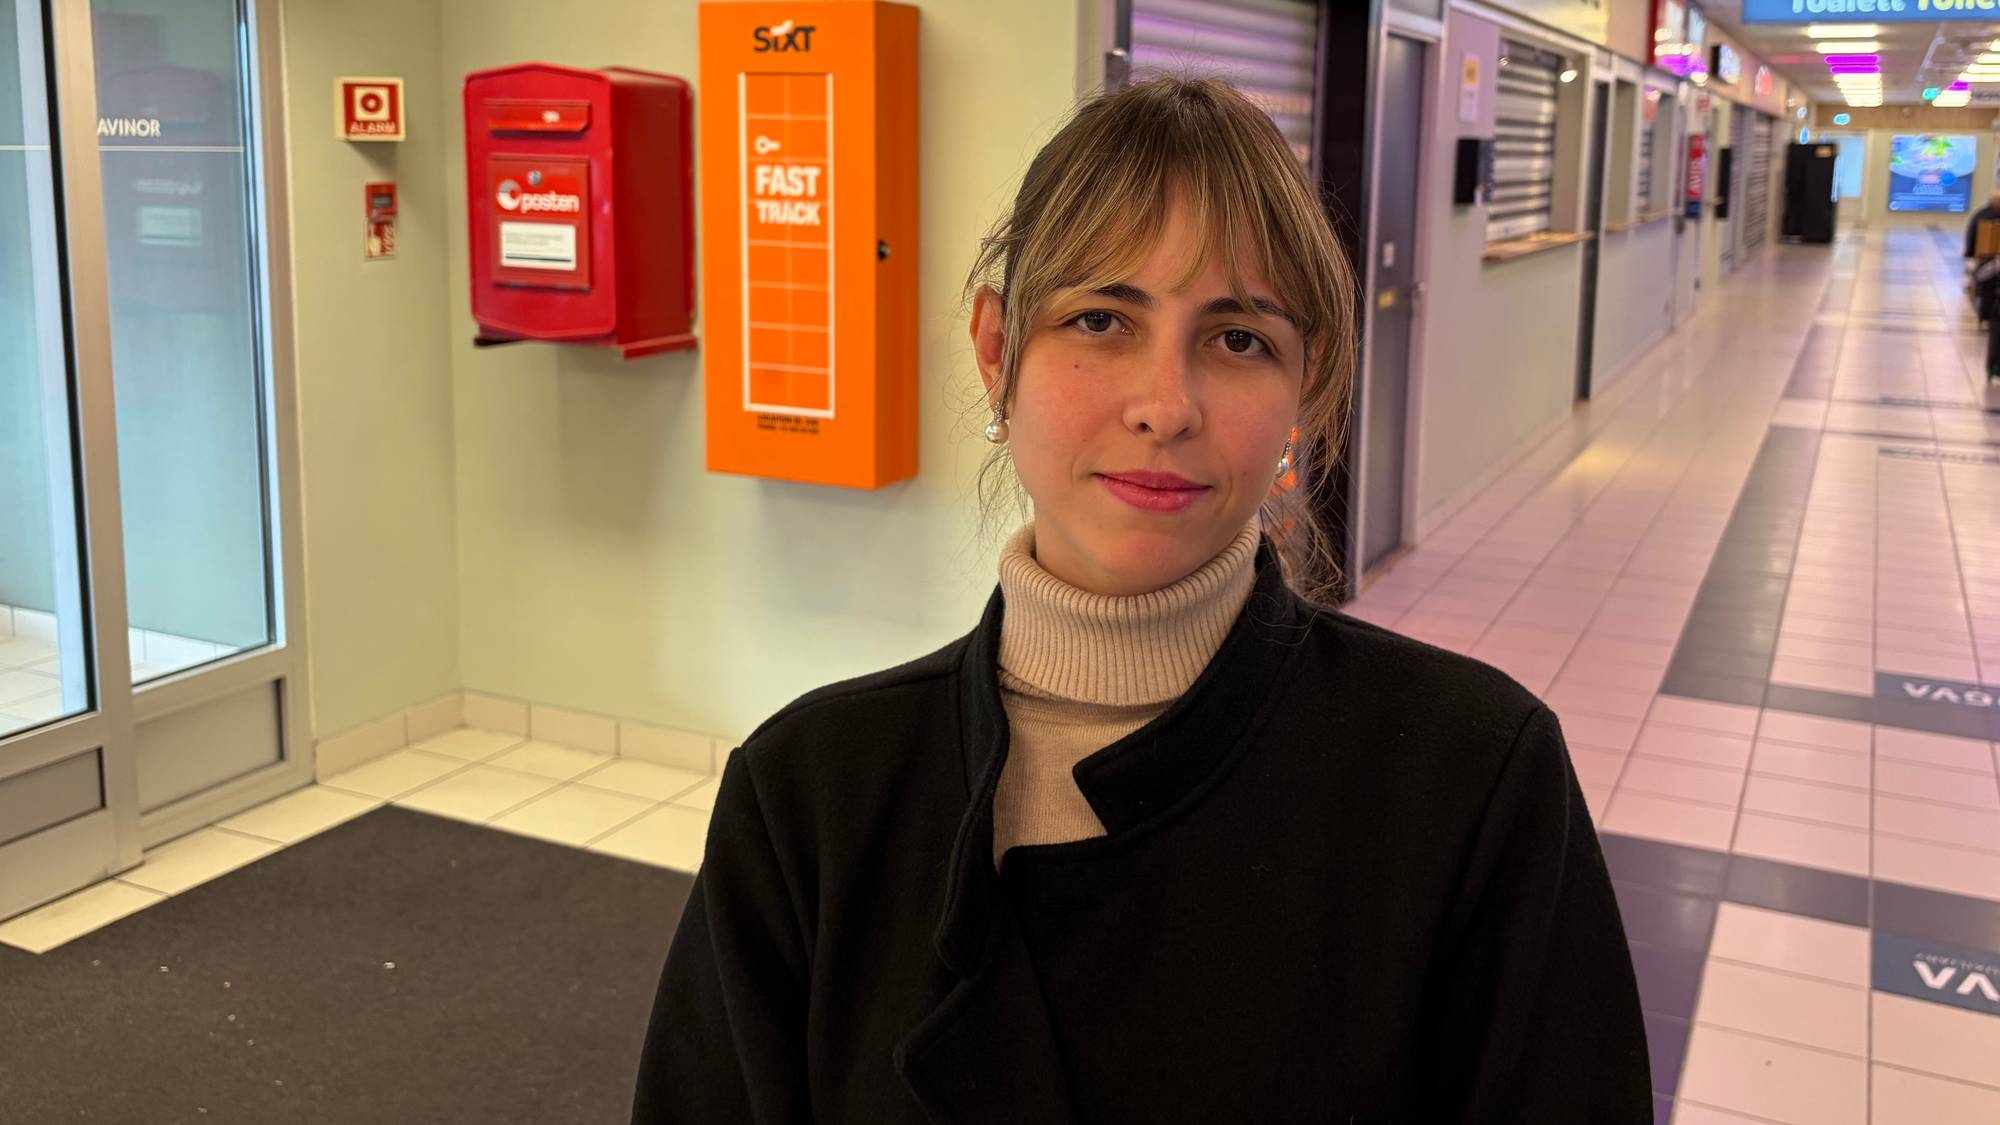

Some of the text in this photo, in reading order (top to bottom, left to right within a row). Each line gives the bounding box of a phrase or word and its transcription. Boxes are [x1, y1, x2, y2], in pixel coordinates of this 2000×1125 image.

[97, 117, 161, 138] AVINOR
[349, 121, 396, 134] ALARM
[755, 165, 821, 197] FAST
[520, 190, 580, 214] posten
[755, 200, 821, 226] TRACK
